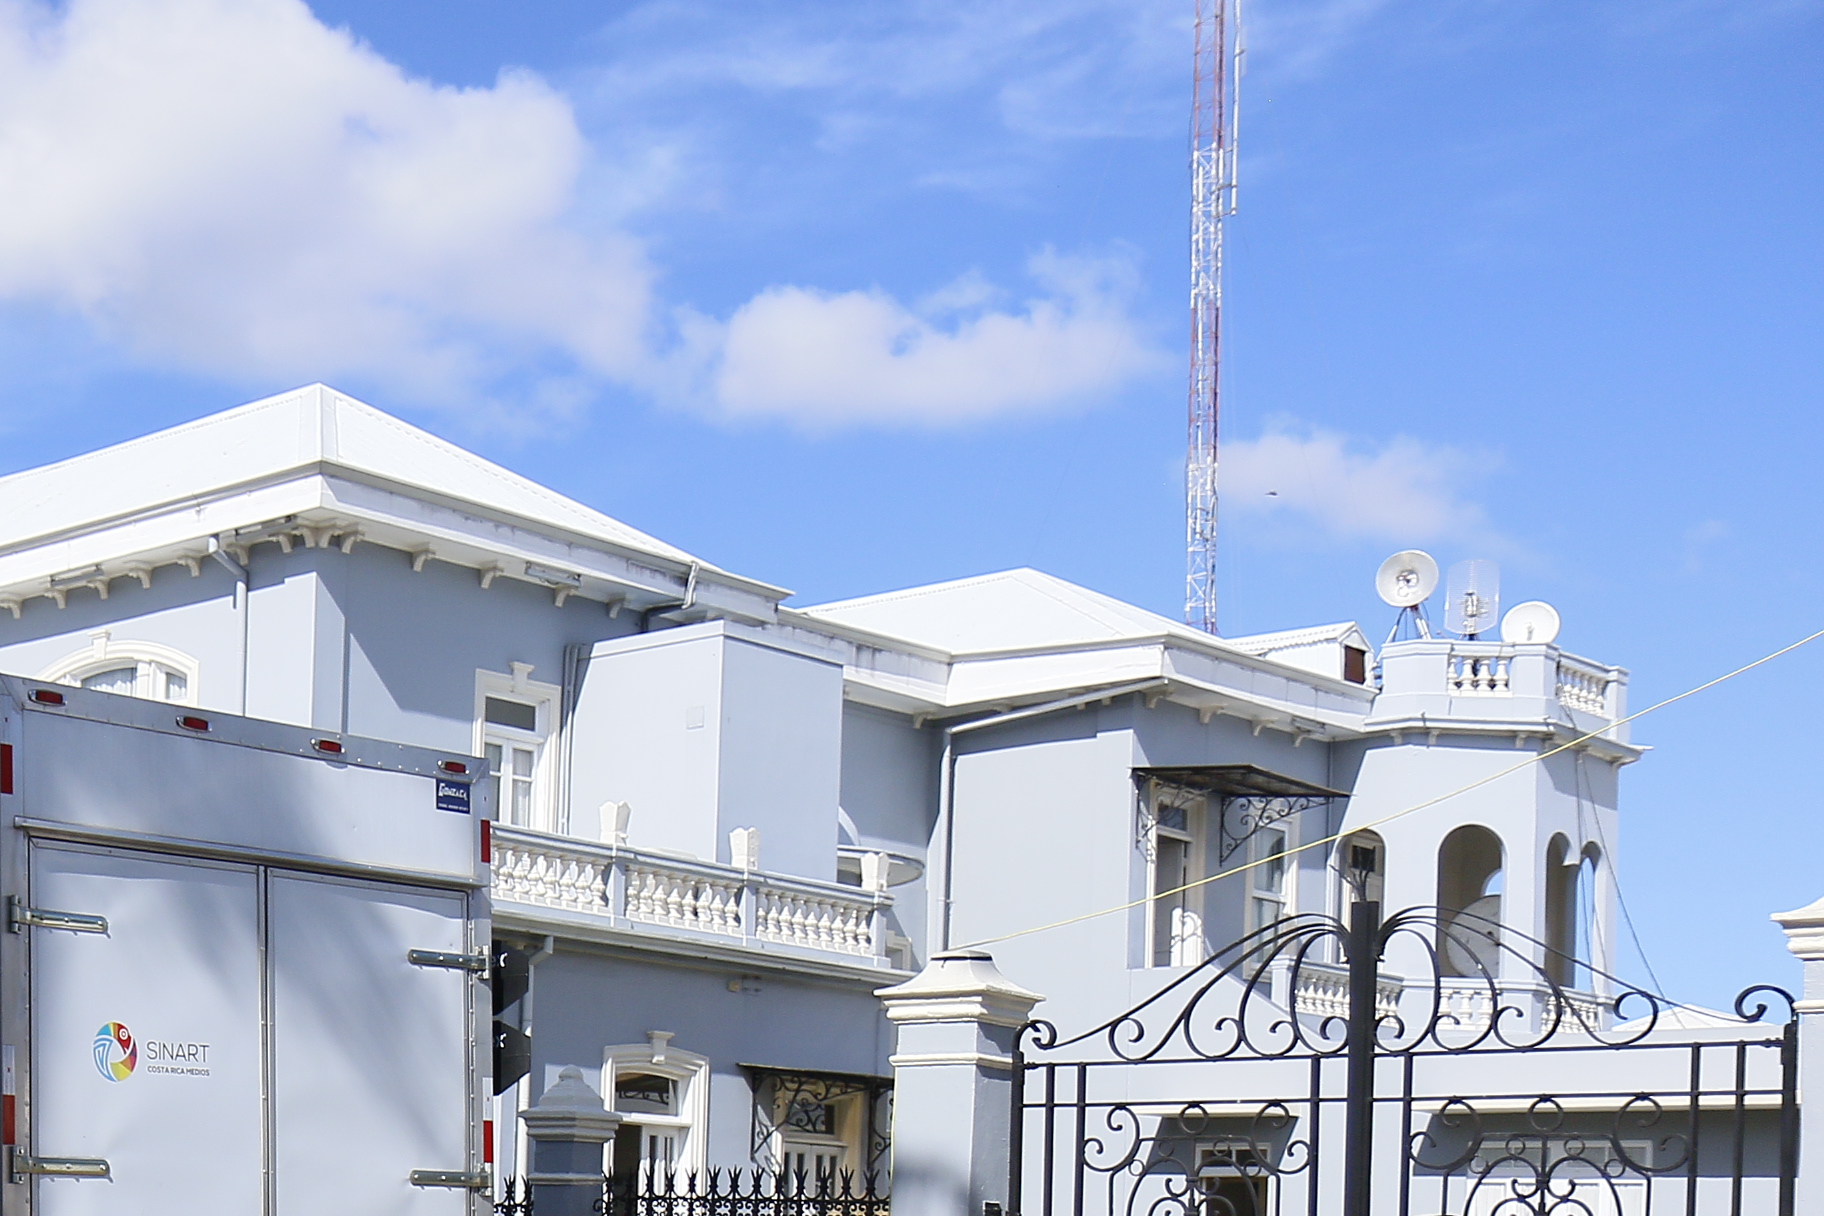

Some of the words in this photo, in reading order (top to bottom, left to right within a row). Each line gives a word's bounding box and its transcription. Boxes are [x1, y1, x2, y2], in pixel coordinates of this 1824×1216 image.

[146, 1040, 210, 1063] SINART
[147, 1065, 170, 1074] COSTA
[171, 1067, 185, 1075] RICA
[186, 1067, 210, 1077] MEDIOS
